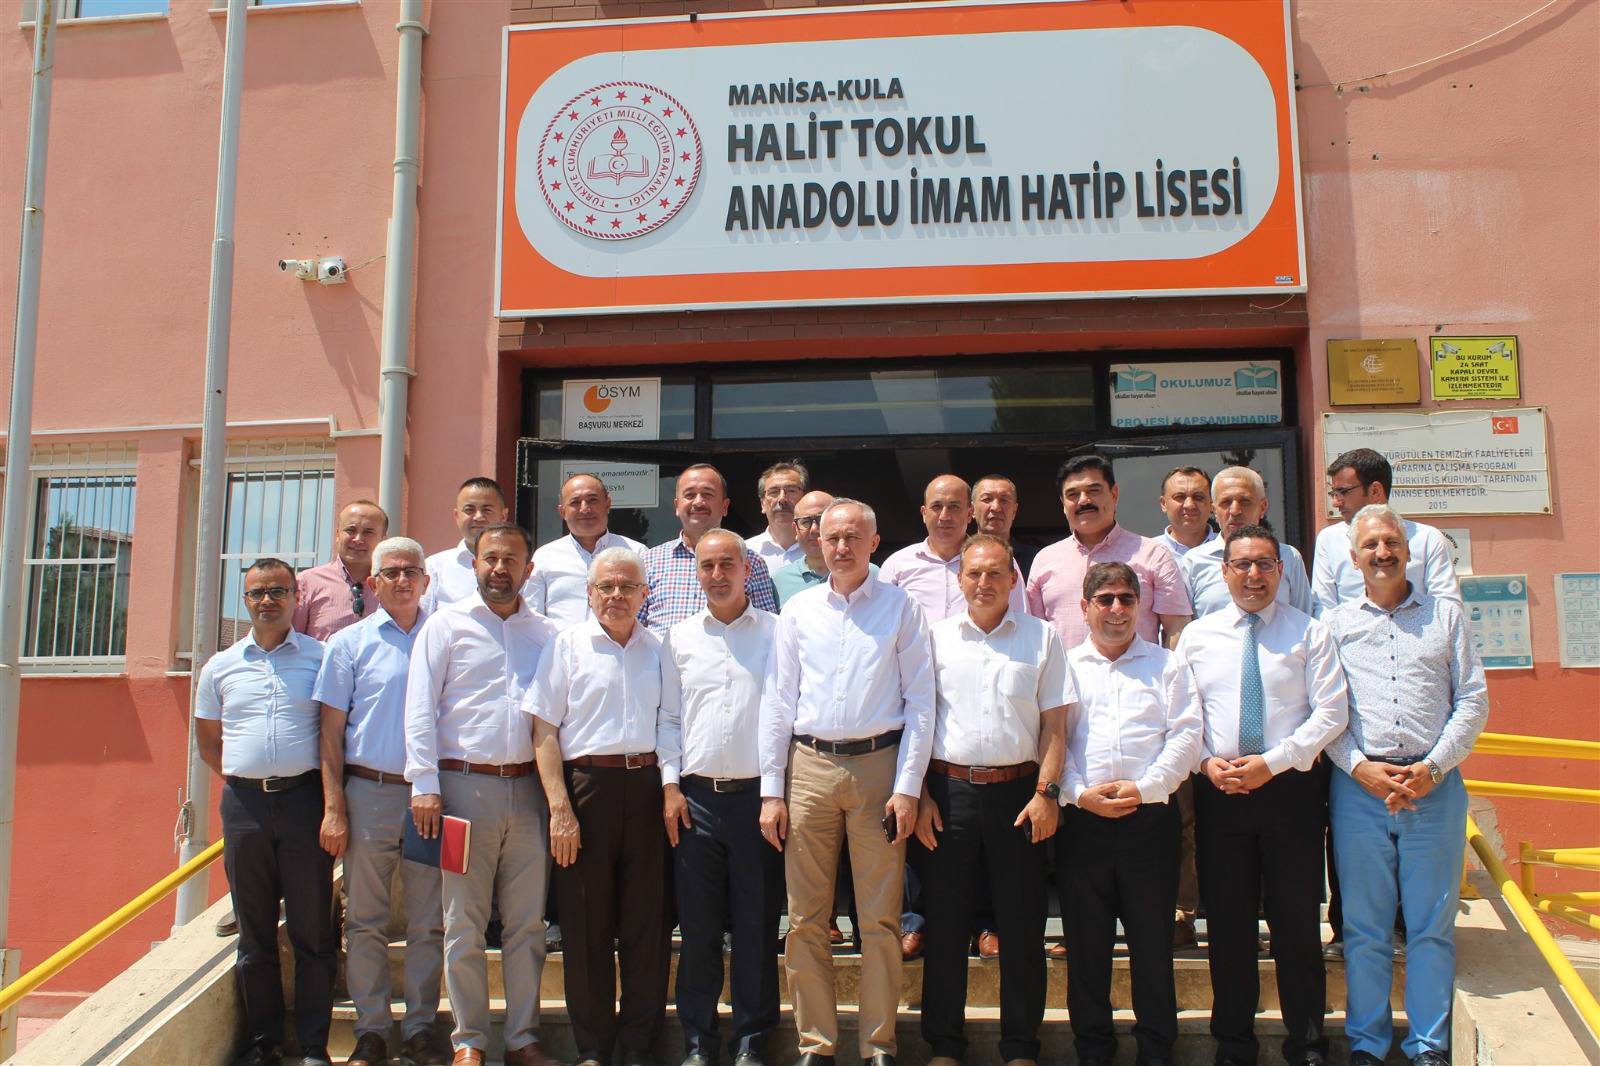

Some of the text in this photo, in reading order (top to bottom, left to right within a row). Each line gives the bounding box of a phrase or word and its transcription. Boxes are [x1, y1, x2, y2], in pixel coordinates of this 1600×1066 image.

[728, 77, 904, 106] MANİSA-KULA
[567, 110, 614, 172] CUMHURİYETİ
[647, 120, 670, 154] EĞİTİM
[728, 111, 986, 162] HALİT TOKUL
[628, 157, 671, 206] BAKANLIĞI
[570, 175, 606, 208] TÜRKİYE
[725, 156, 1243, 231] ANADOLU İMAM HATİP LİSESİ
[1160, 378, 1232, 389] OKULUMUZ
[598, 384, 641, 399] ÖSYM
[578, 418, 644, 431] BAŞVURU MERKEZİ
[1116, 415, 1170, 427] PROJESİ
[1384, 446, 1533, 459] YÜRÜTÜLEN TEMİZLİK FAALİYETLERİ
[1391, 461, 1516, 473] YARARINA ÇALIŞMA PROGRAMI
[1483, 474, 1537, 483] TARAFINDAN
[1428, 501, 1448, 510] 2015
